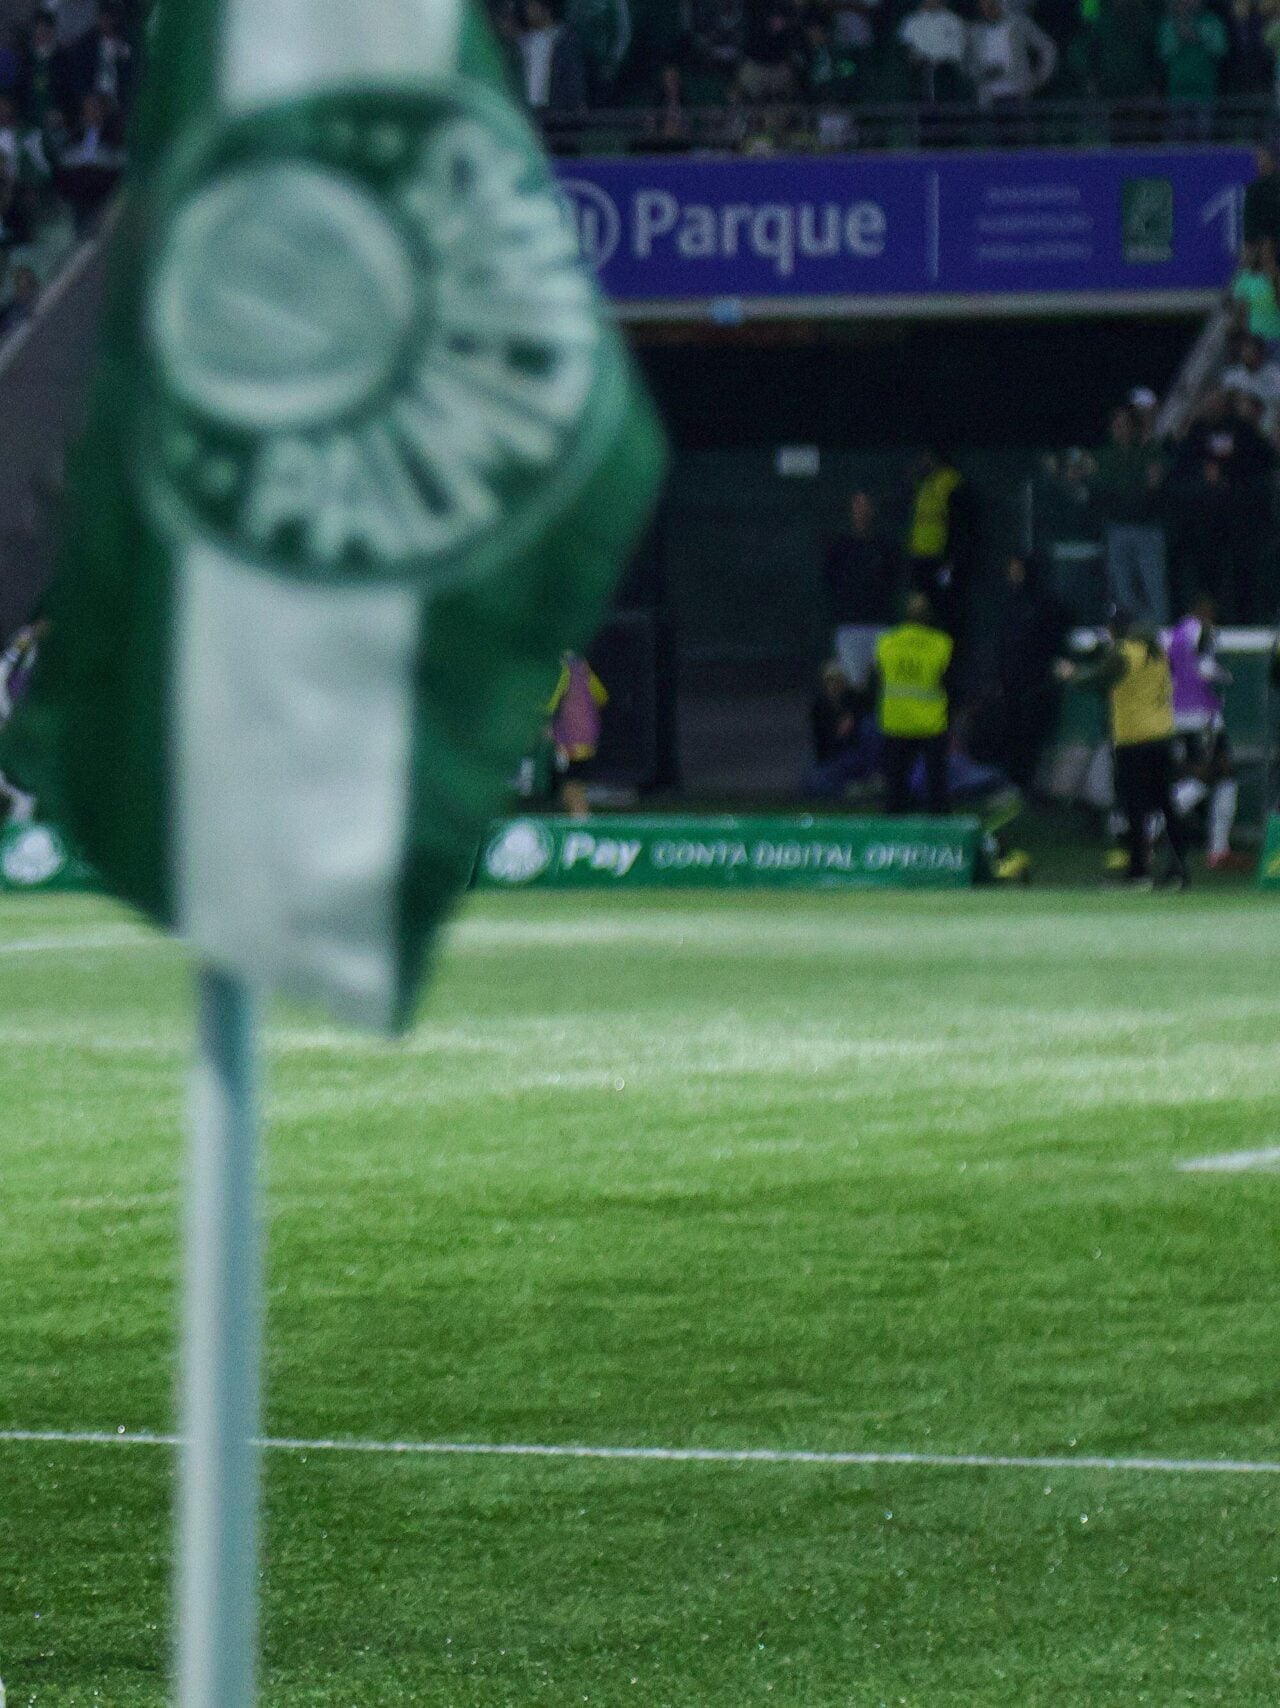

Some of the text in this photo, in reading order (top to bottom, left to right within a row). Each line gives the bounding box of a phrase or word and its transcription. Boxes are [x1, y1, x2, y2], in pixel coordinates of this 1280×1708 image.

[632, 189, 887, 277] Parque
[562, 832, 642, 877] Pay
[651, 839, 748, 871] CONTA
[751, 839, 855, 871] DIGITAL
